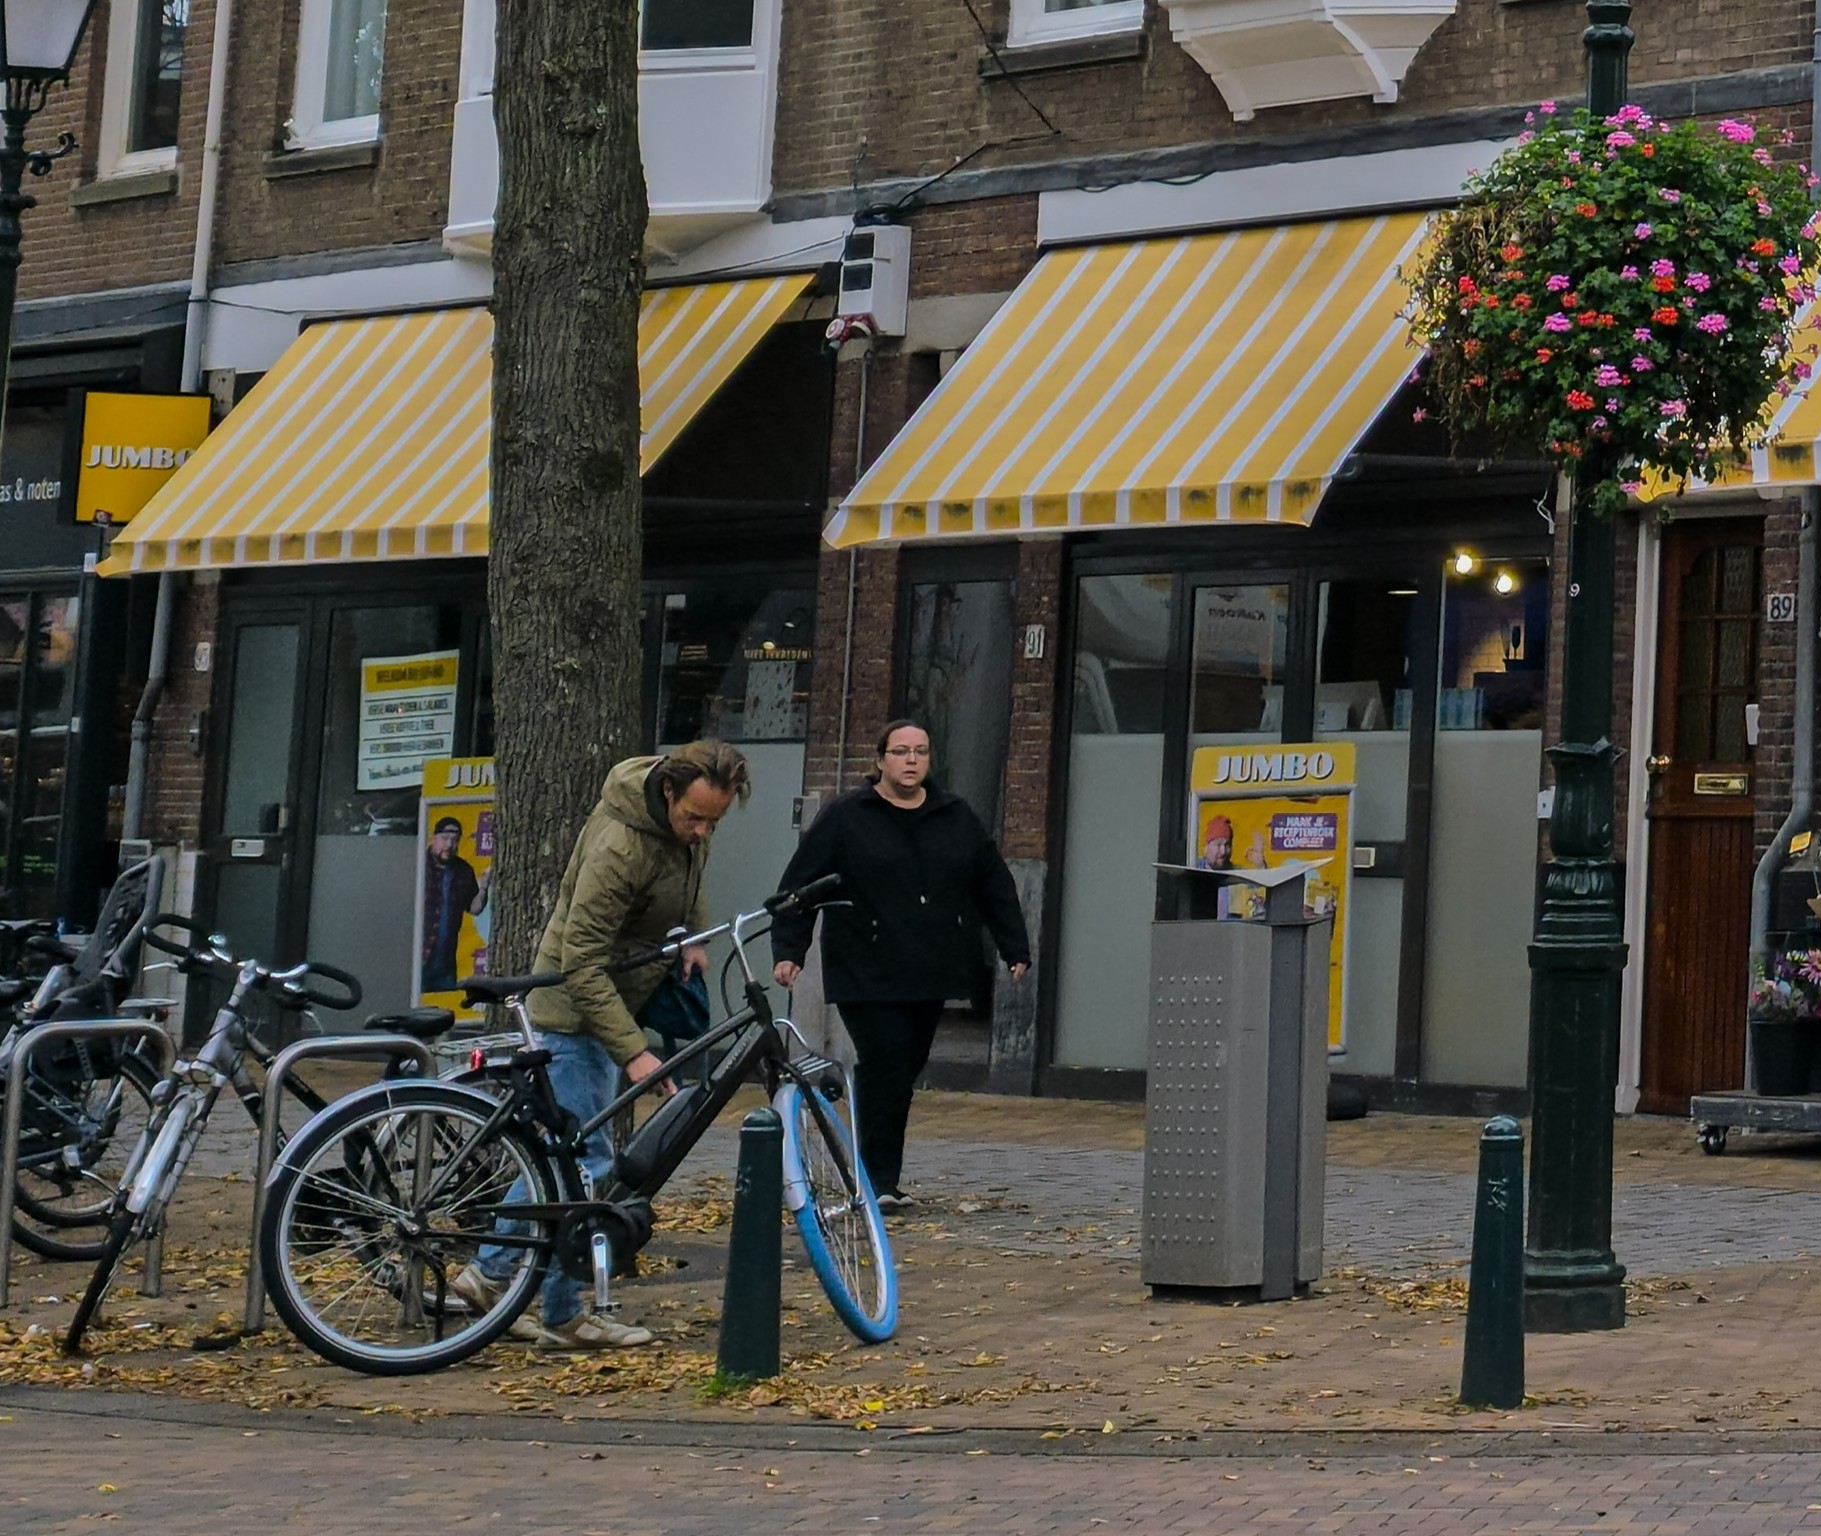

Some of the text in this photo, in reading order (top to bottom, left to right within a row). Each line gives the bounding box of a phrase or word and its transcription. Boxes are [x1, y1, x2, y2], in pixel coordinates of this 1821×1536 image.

[0, 477, 62, 502] as & noten
[1770, 596, 1792, 620] 89
[1028, 628, 1042, 655] 91
[1212, 752, 1335, 784] JUMBO
